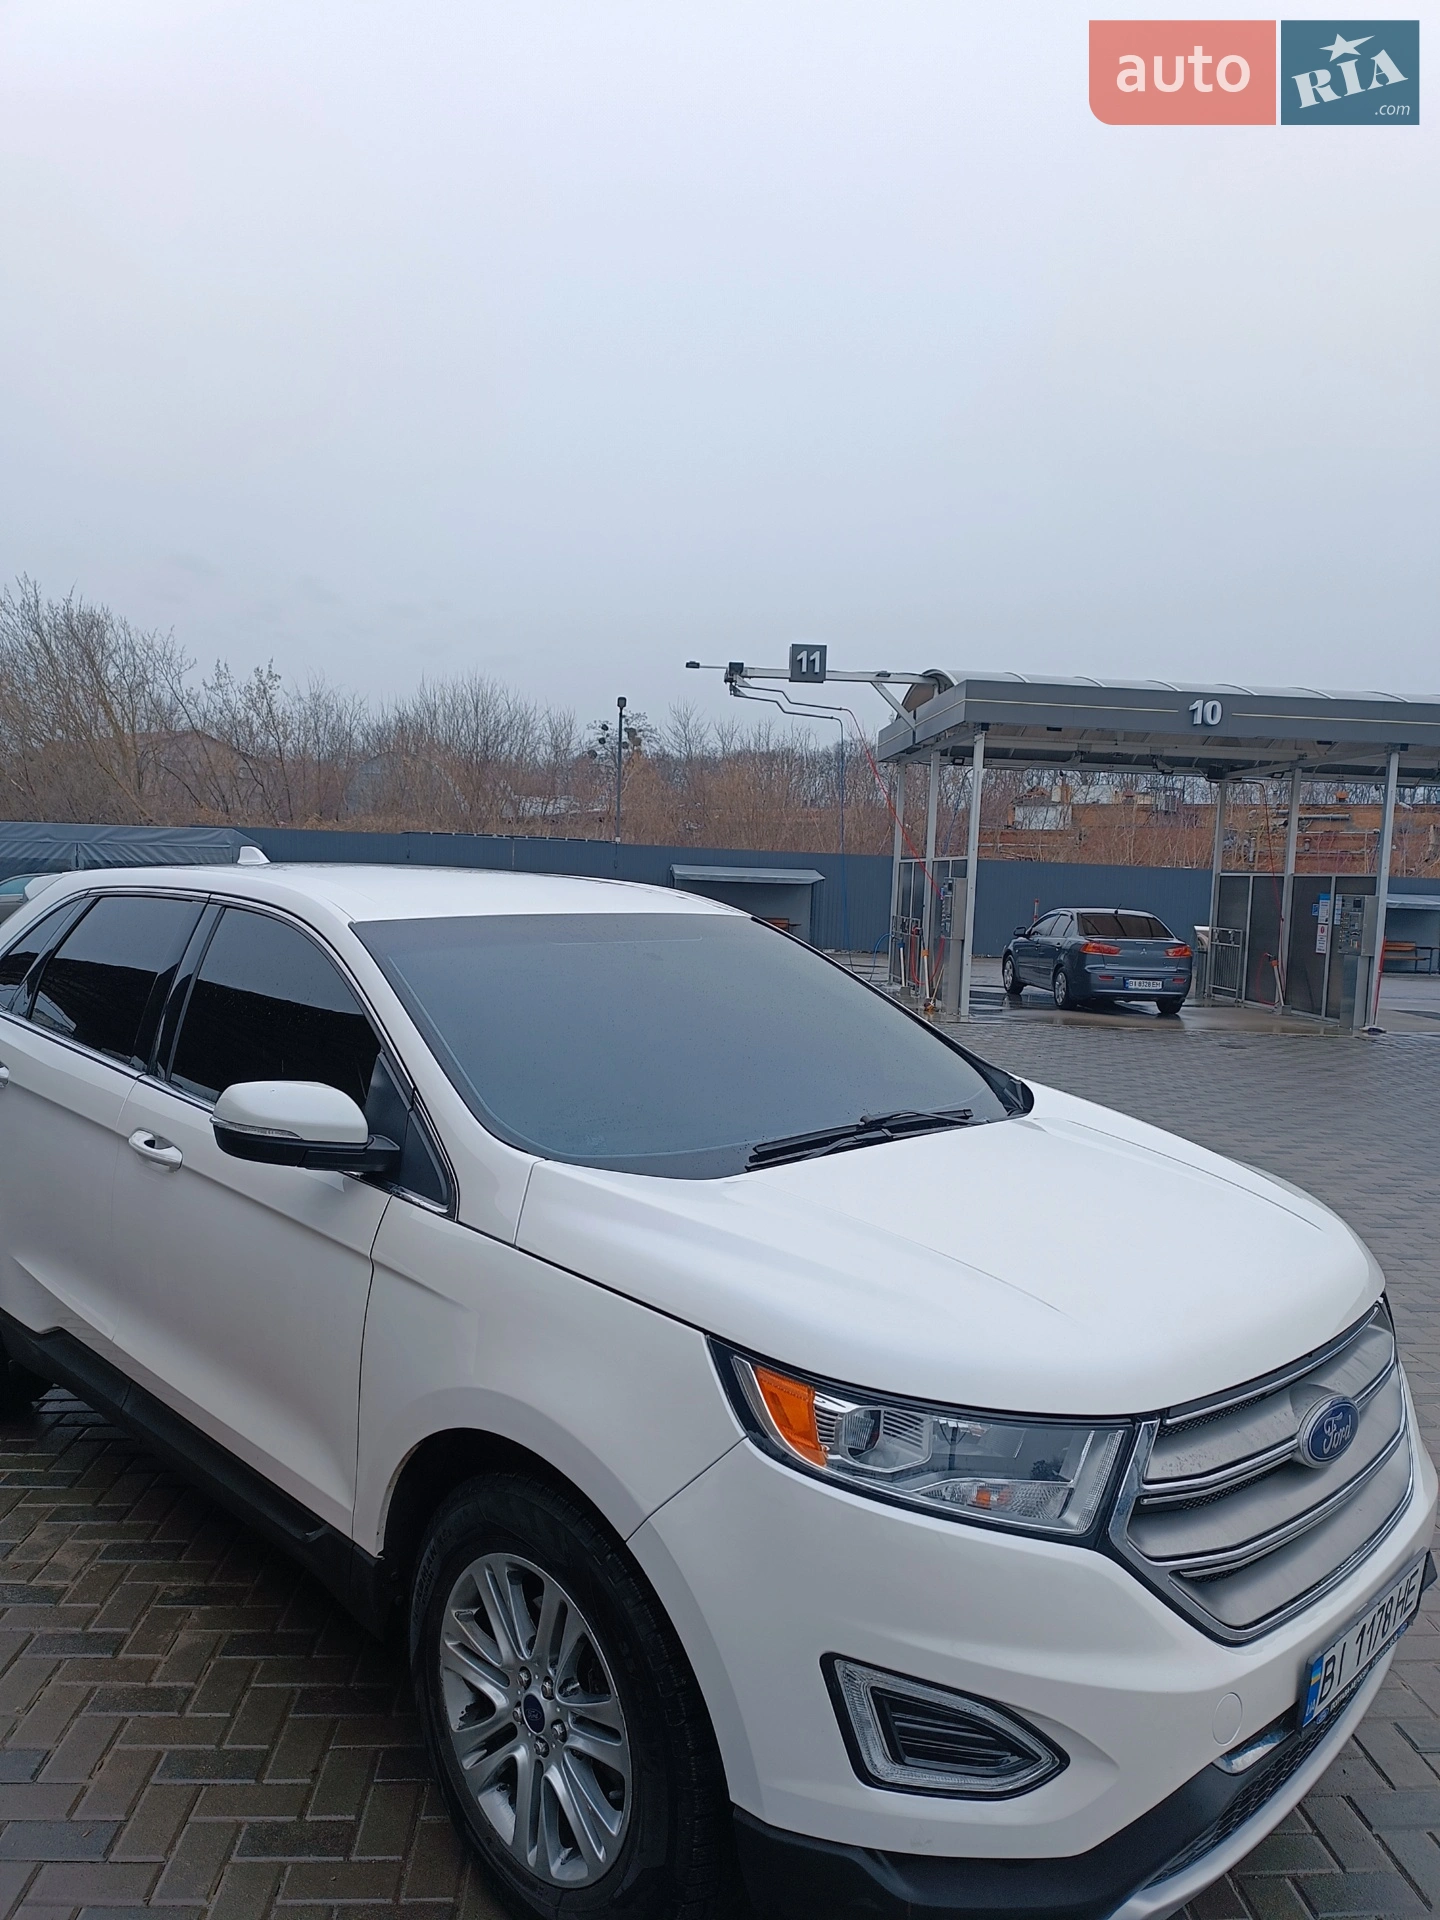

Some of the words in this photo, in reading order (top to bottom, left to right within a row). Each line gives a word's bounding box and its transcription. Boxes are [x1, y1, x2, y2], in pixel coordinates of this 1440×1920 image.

[796, 650, 821, 673] 11
[1188, 699, 1223, 726] 10
[1322, 1411, 1352, 1455] Ford
[1317, 1641, 1347, 1706] BI
[1355, 1595, 1394, 1667] 1178
[1392, 1567, 1420, 1627] HE
